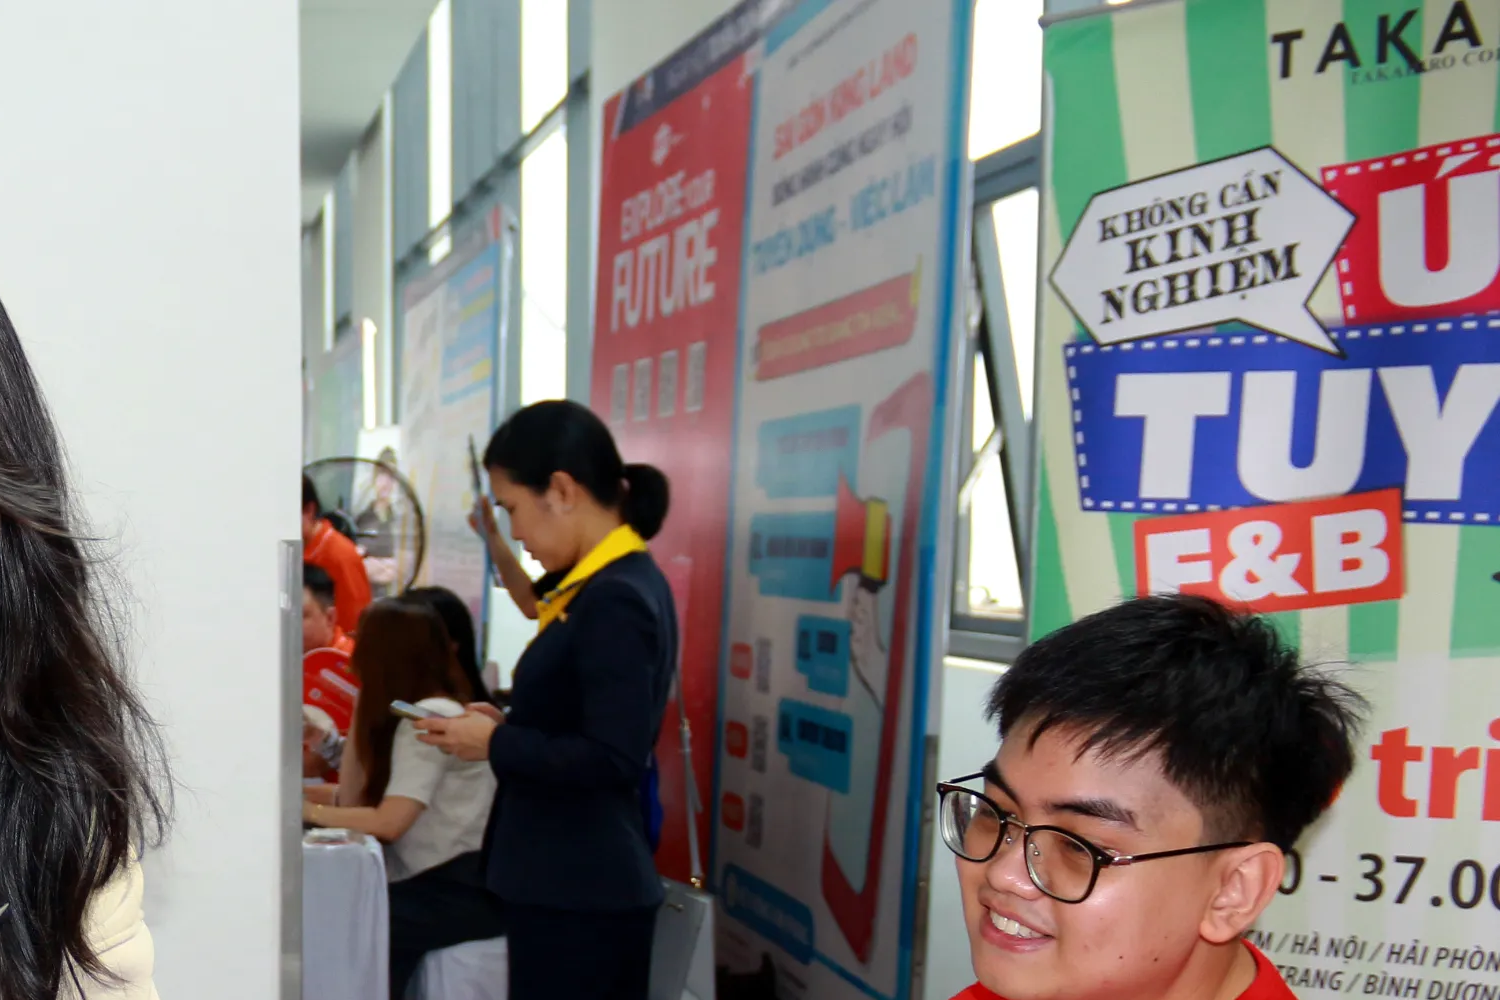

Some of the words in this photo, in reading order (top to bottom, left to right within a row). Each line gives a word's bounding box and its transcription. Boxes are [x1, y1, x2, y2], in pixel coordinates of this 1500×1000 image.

[1097, 191, 1209, 243] KHÔNG
[1124, 206, 1263, 274] KINH
[610, 207, 721, 334] FUTURE
[1099, 242, 1301, 325] NGHIỆM
[1145, 508, 1391, 600] F&B
[1354, 853, 1500, 911] 37.0
[1290, 931, 1319, 956] HÀ
[1325, 935, 1368, 964] NỘI
[1385, 938, 1430, 966] HẢI
[1362, 969, 1421, 999] BÌNH
